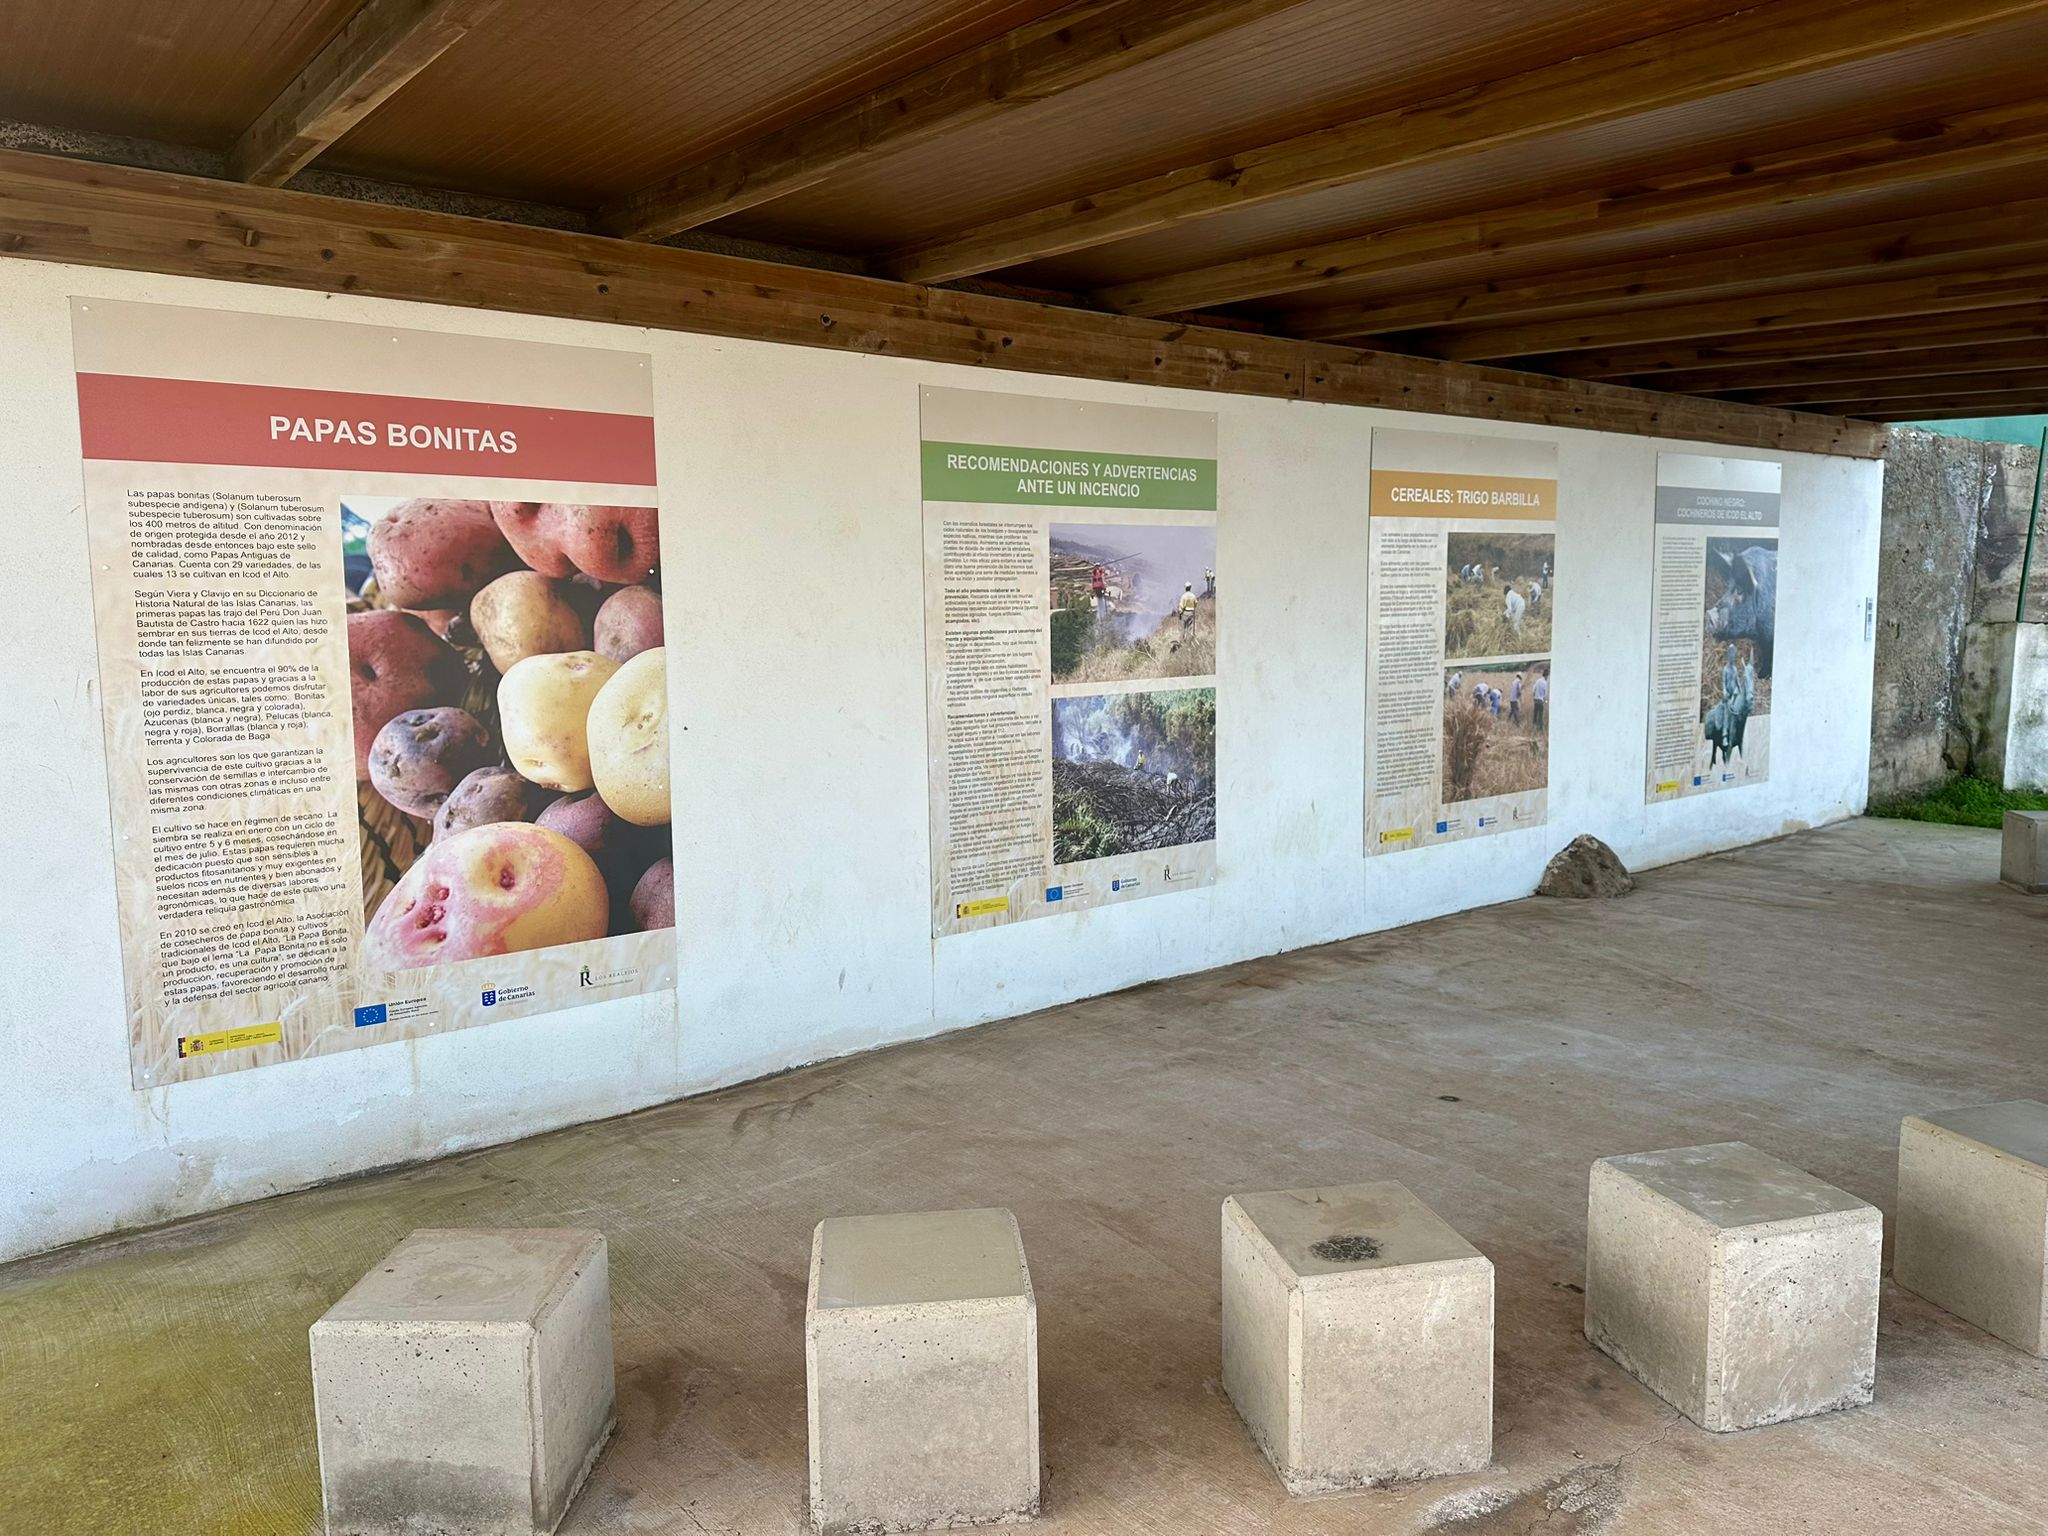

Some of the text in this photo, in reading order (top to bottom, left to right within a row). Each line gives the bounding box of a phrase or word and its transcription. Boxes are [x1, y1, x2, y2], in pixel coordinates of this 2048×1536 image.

[270, 415, 518, 454] PAPAS BONITAS
[947, 454, 1197, 482] RECOMENDACIONES Y ADVERTENCIAS
[1017, 479, 1140, 498] ANTE UN INCENCIO
[177, 491, 209, 499] bonitas
[212, 491, 254, 501] (Solanum
[1391, 487, 1540, 506] CEREALES: TRIGO BARBILLA
[1696, 496, 1722, 506] COCHINO
[127, 500, 180, 509] subespecie
[237, 502, 278, 511] (Solanum
[128, 510, 180, 518] subespecie
[183, 511, 233, 521] tuberosum)
[1677, 507, 1762, 520] COCHINEROS DE ICOD EL ALTO
[175, 531, 217, 540] protegida
[256, 542, 274, 551] bajo
[210, 550, 238, 559] Papas
[240, 551, 277, 560] Antiguas
[134, 589, 164, 599] Según
[200, 589, 230, 598] Clavijo
[223, 610, 242, 618] trajo
[271, 618, 294, 626] quien
[141, 678, 190, 688] producción
[268, 676, 298, 684] gracias
[166, 755, 217, 765] agricultores
[270, 749, 314, 759] garantizan
[148, 775, 207, 785] conservación
[222, 771, 257, 779] semillas
[267, 767, 315, 776] intercambio
[149, 795, 193, 804] diferentes
[196, 791, 247, 801] condiciones
[249, 788, 291, 796] climáticas
[156, 882, 185, 891] suelos
[224, 873, 266, 883] nutrientes
[295, 866, 334, 875] abonados
[173, 935, 224, 947] cosecheros
[239, 930, 260, 939] papa
[263, 926, 288, 935] bonita
[297, 921, 328, 930] cultivos
[580, 972, 594, 987] R
[498, 986, 529, 995] Gobierno
[507, 991, 535, 1000] Canarias
